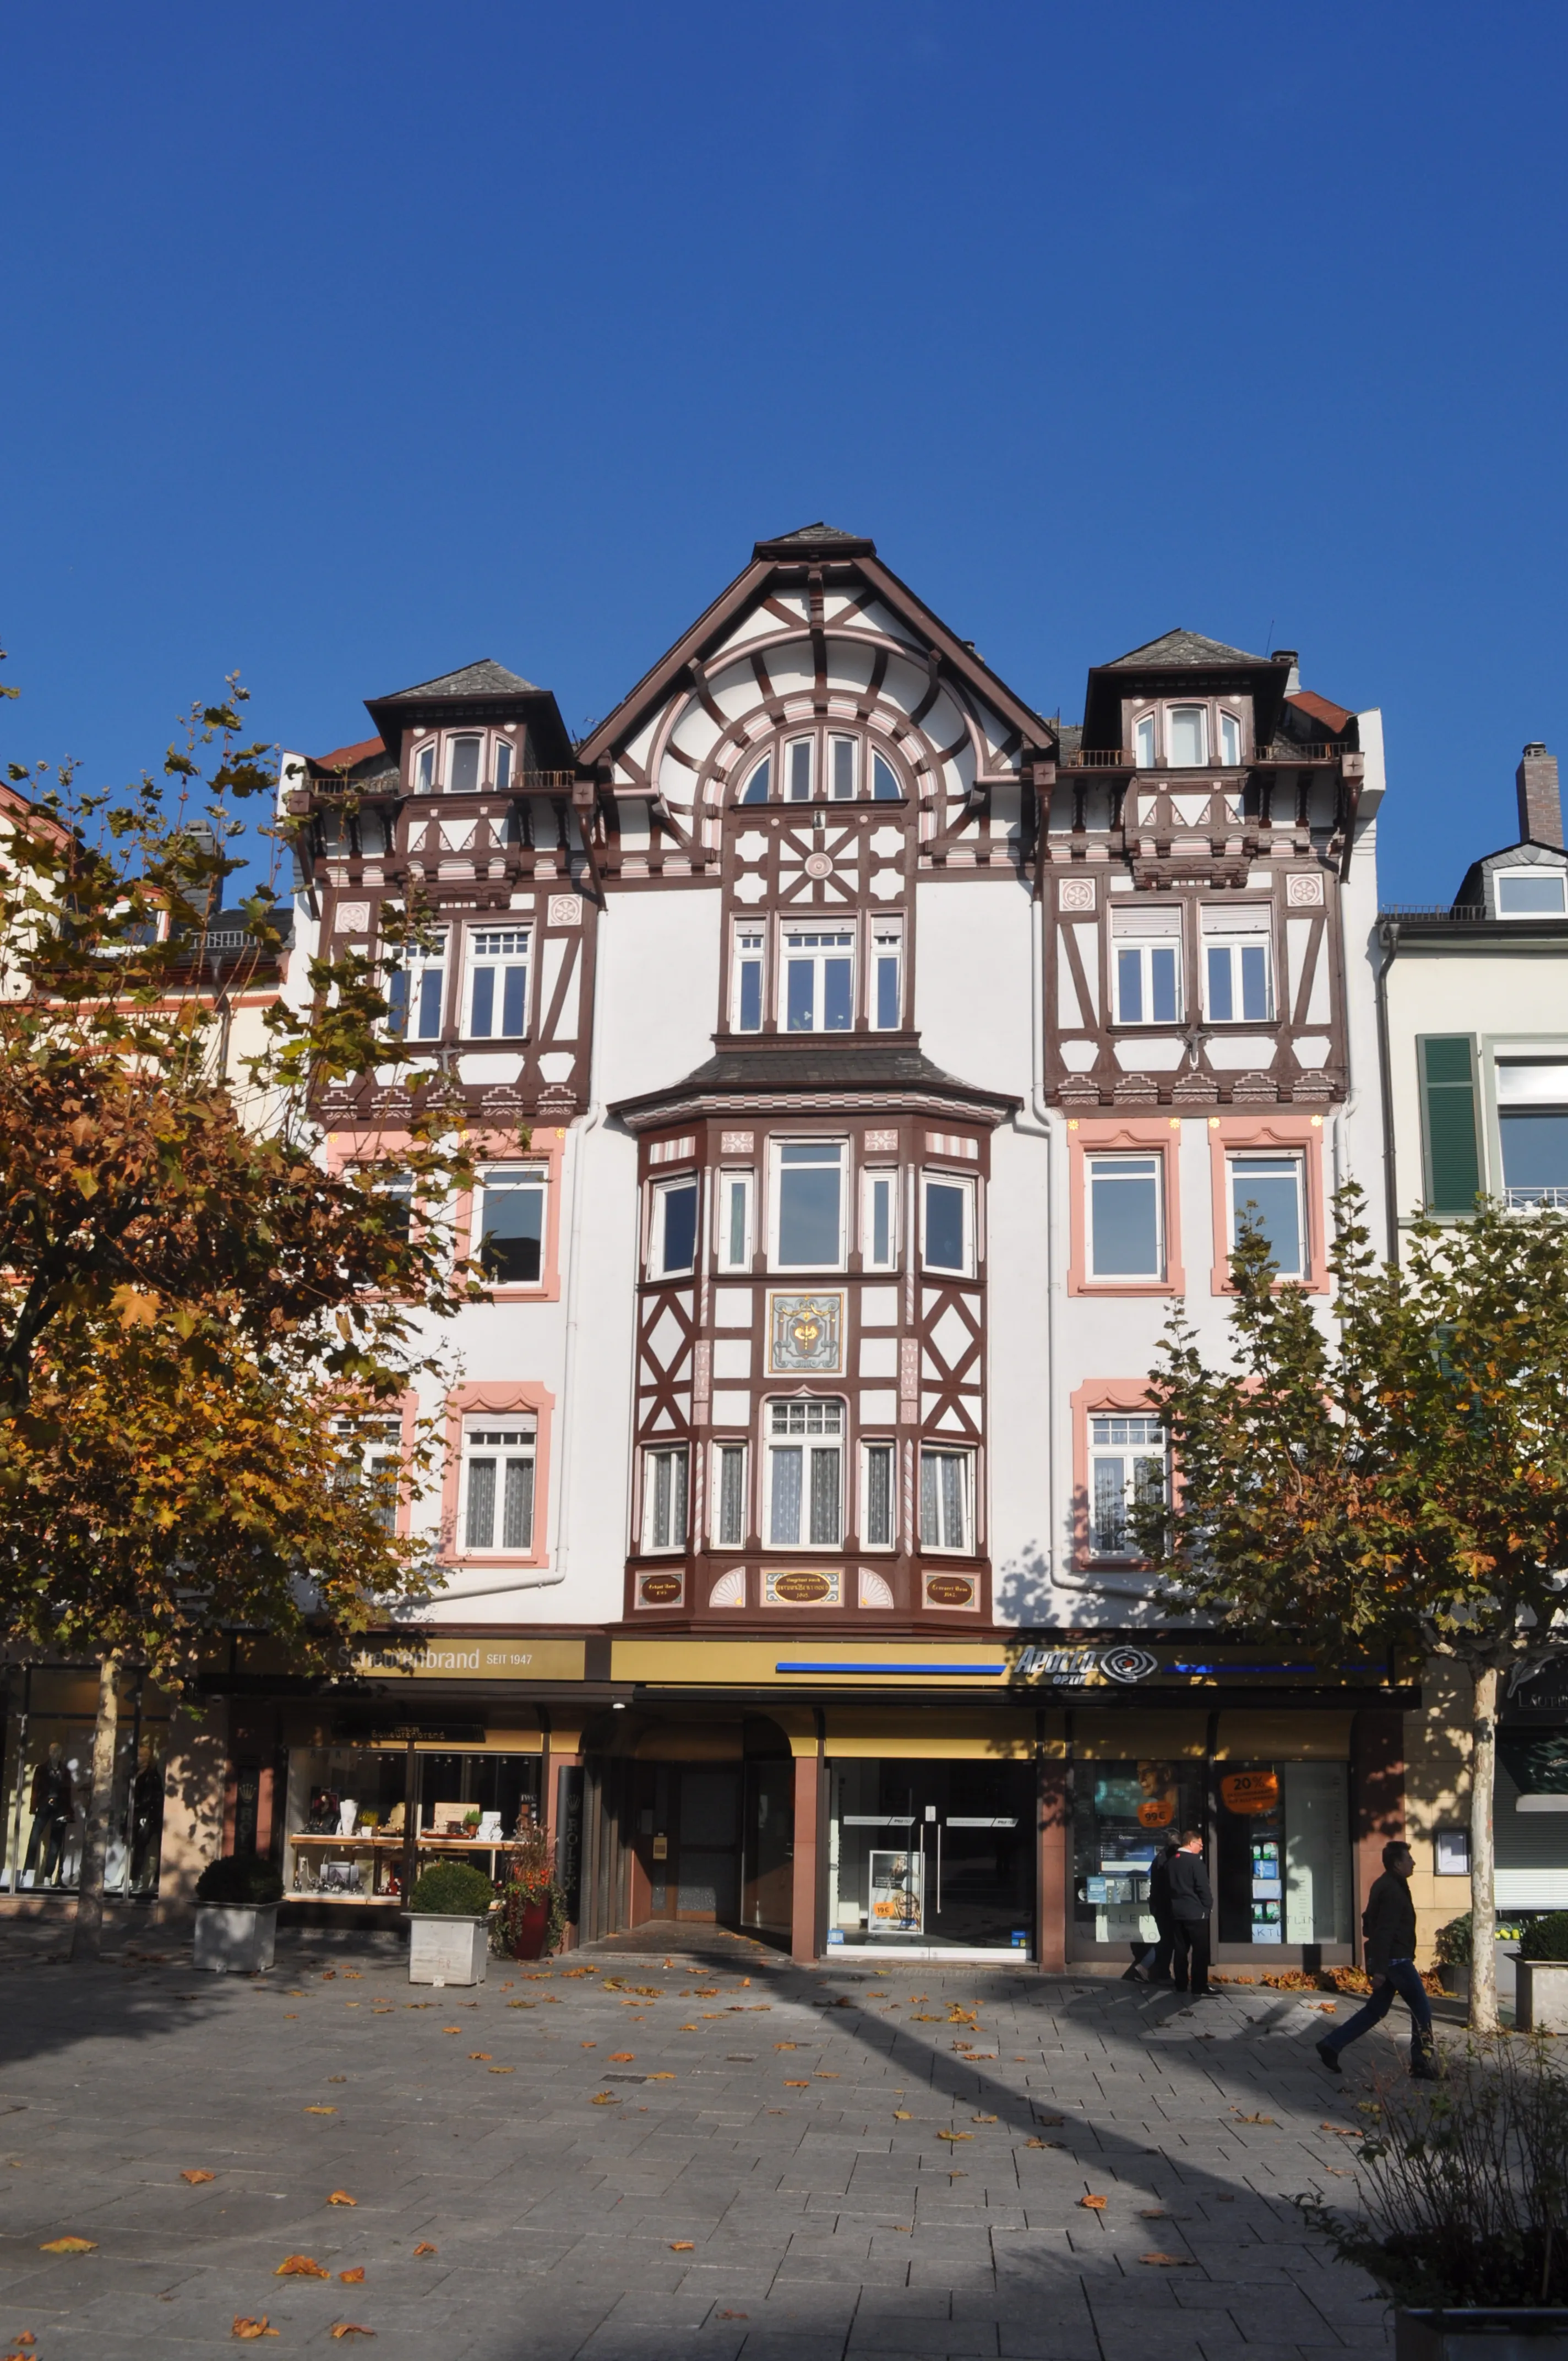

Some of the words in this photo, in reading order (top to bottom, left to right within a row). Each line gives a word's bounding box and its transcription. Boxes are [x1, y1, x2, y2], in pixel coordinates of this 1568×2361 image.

[337, 1645, 480, 1670] Scheurenbrand
[486, 1654, 507, 1664] SEIT
[510, 1654, 532, 1666] 1947
[1013, 1646, 1097, 1674] APOLLO
[371, 1729, 445, 1739] Scheurenbrand
[564, 1818, 578, 1890] ROLEX
